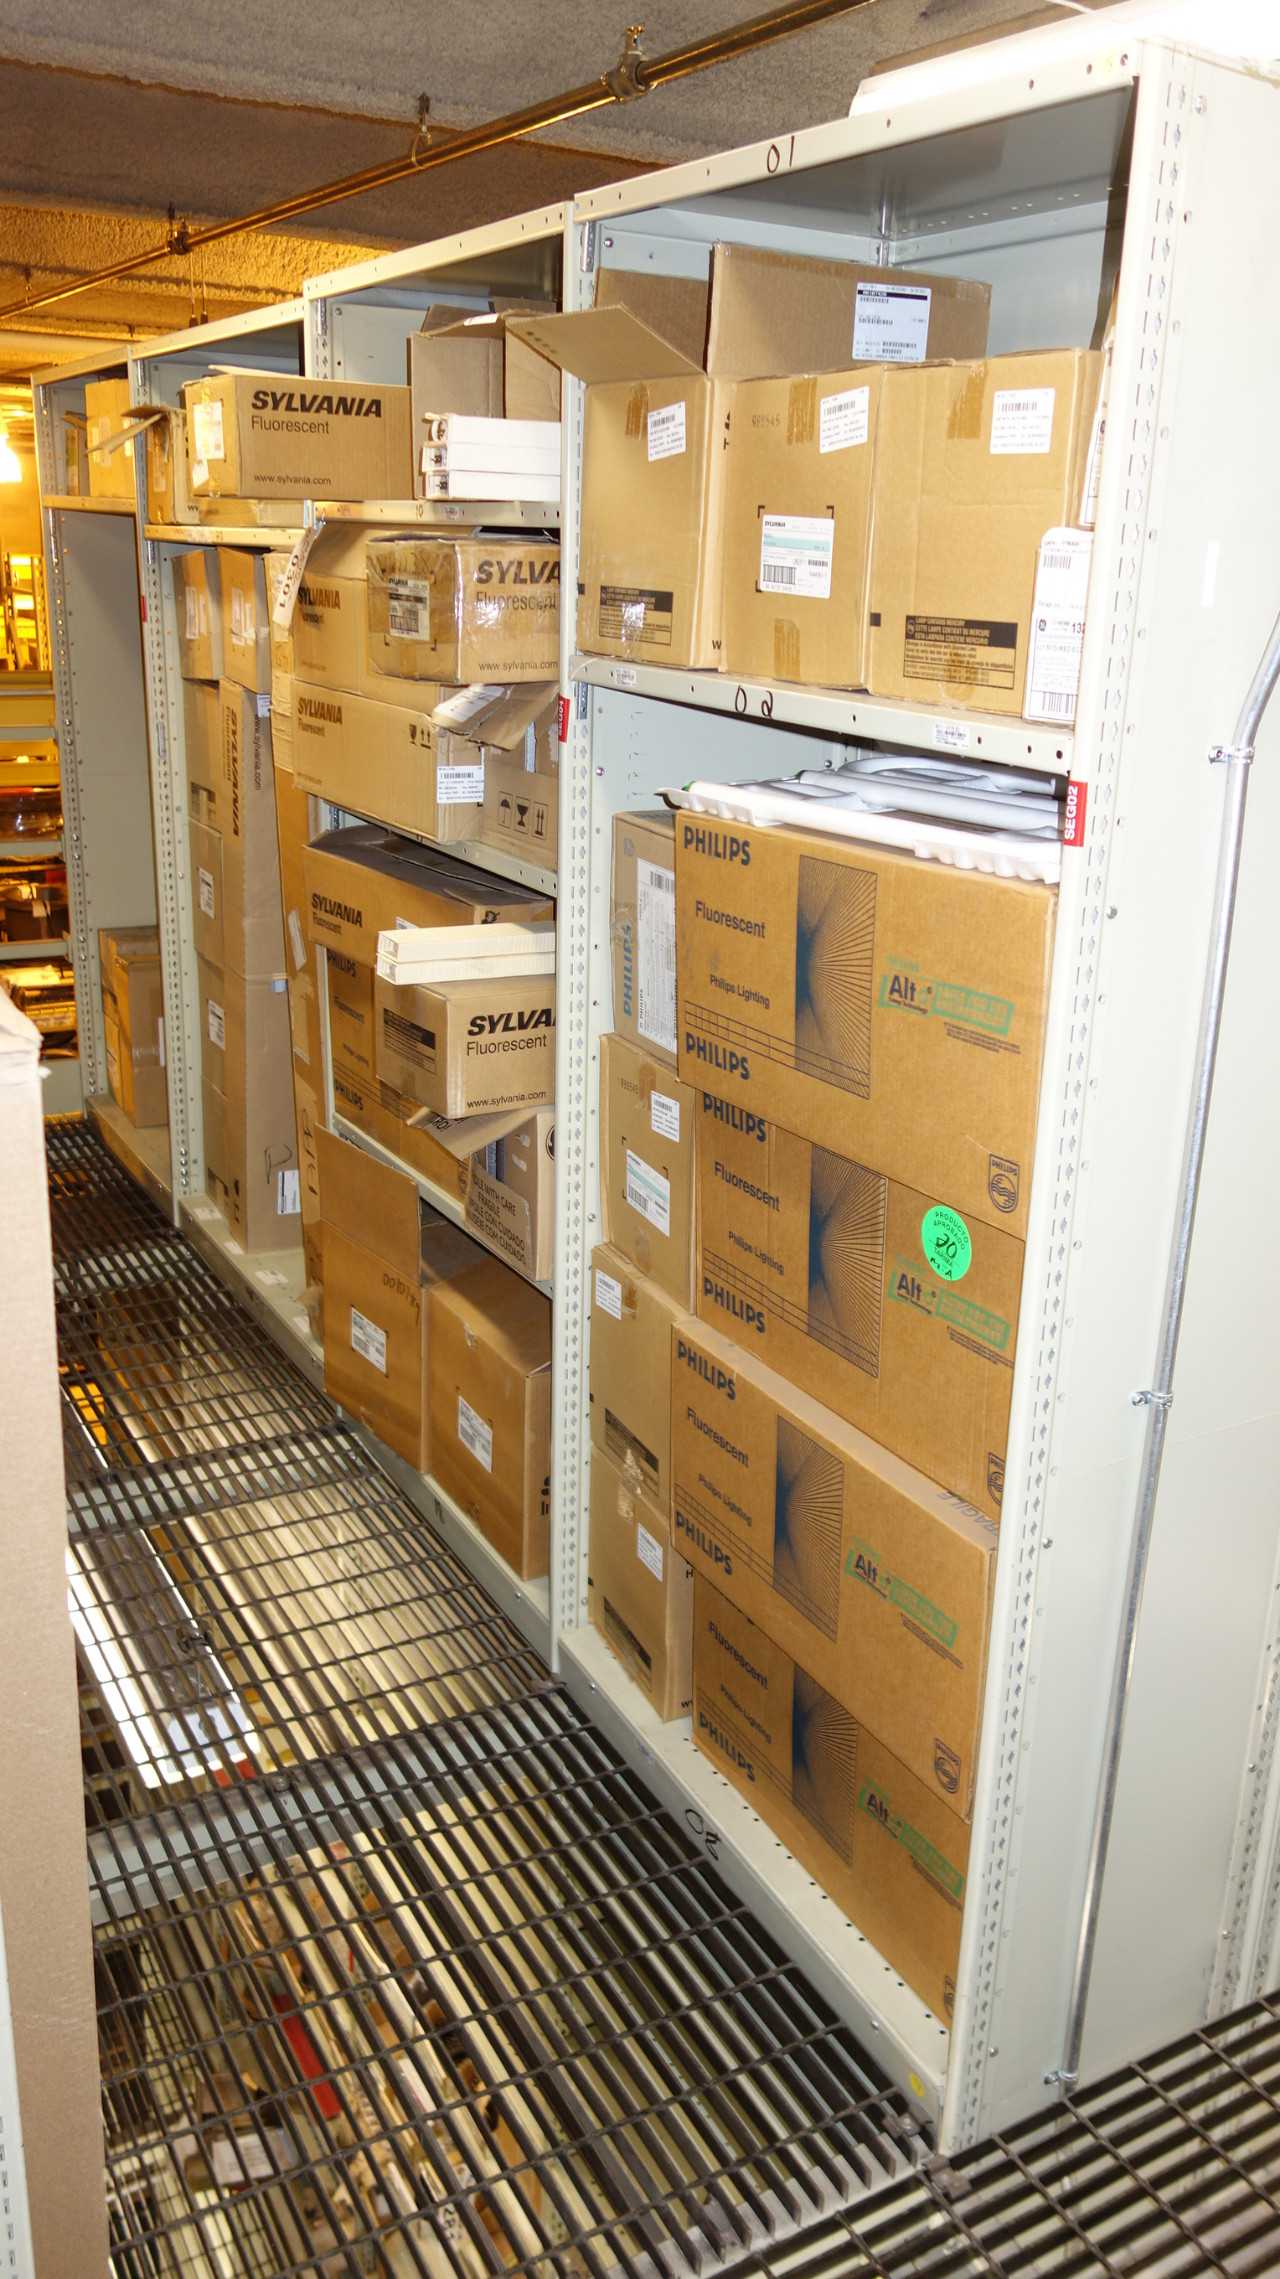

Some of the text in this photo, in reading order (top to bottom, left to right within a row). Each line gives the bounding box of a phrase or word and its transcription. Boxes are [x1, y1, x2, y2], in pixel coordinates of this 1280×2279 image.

[251, 390, 383, 418] SYLVANIA
[251, 415, 330, 434] Fluorescent
[254, 474, 331, 486] www.sylvania.com
[478, 660, 559, 673] www.sylvania.com
[298, 697, 343, 725] SYLVANIA
[231, 708, 240, 837] SYLVANIA
[1064, 785, 1079, 840] SEG02
[684, 825, 751, 866] PHILIPS
[311, 893, 363, 927] SYLVANIA
[695, 900, 766, 939] Fluorescent
[623, 924, 632, 1017] PHILIPS
[710, 974, 770, 1010] Philips Lighting
[467, 1008, 556, 1037] SYLVA
[466, 1034, 548, 1057] Fluorescent
[686, 1031, 750, 1080] PHILIPS
[467, 1090, 547, 1110] www.sylvania.com
[703, 1092, 766, 1142] PHILIPS
[500, 1194, 516, 1216] CARE
[714, 1161, 780, 1212] Fluorescent
[935, 1211, 969, 1244] PRODUCTO
[728, 1230, 785, 1276] Philips Lighting
[704, 1277, 765, 1334] PHILIPS
[677, 1340, 736, 1400] PHILIPS
[687, 1406, 749, 1468] Fluorescent
[676, 1511, 732, 1575] PHILIPS
[708, 1620, 769, 1690] Fluorescent
[700, 1711, 755, 1783] PHILIPS
